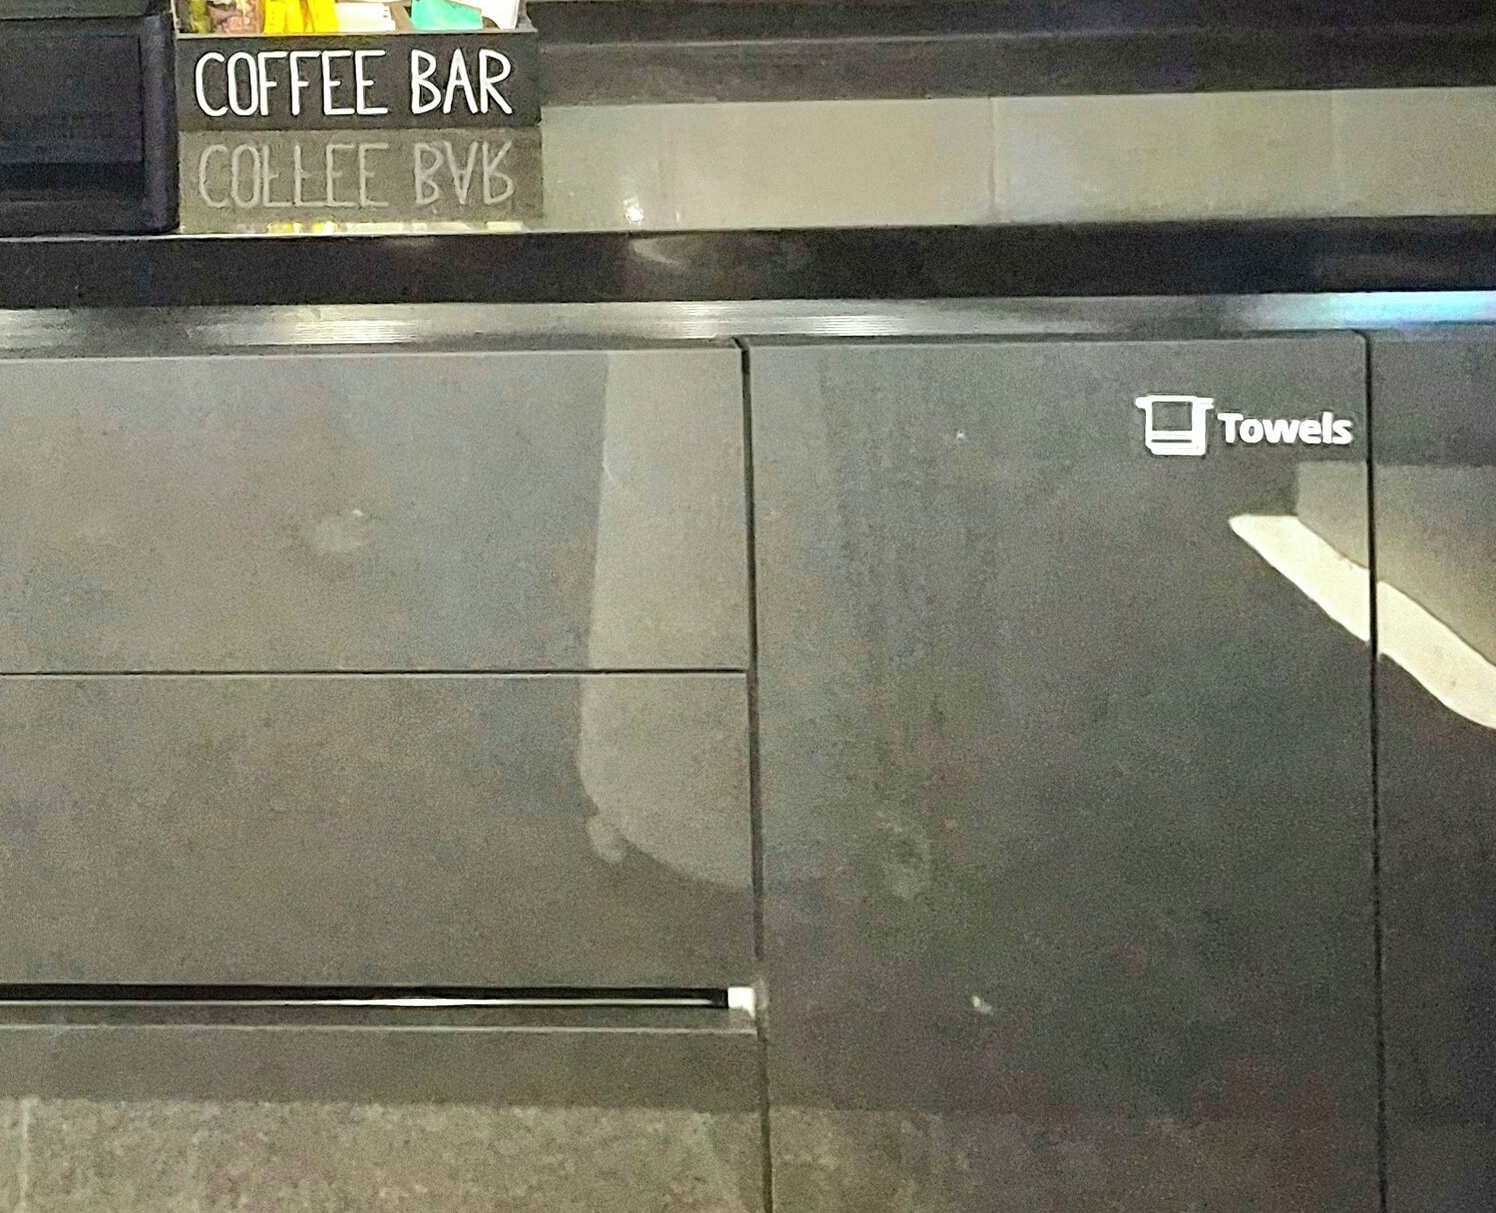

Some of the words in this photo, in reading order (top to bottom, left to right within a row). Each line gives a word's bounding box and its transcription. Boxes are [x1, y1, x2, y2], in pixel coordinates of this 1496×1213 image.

[194, 50, 389, 117] COFFEE
[411, 47, 513, 115] BAR
[1217, 411, 1353, 445] Towels
